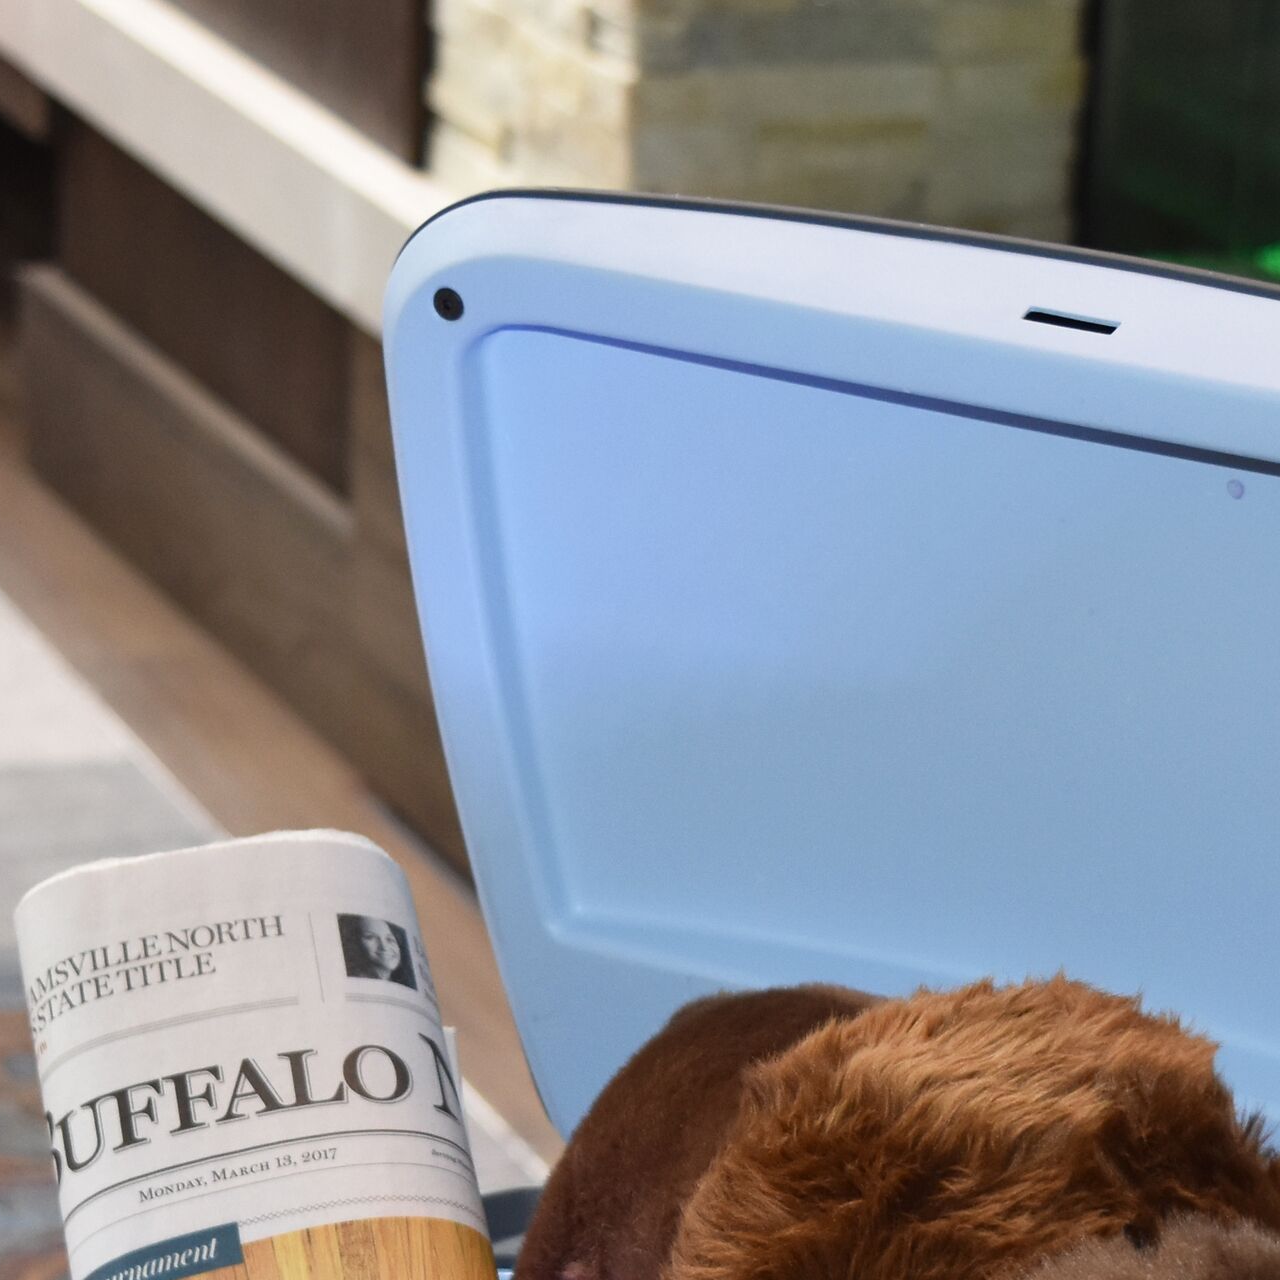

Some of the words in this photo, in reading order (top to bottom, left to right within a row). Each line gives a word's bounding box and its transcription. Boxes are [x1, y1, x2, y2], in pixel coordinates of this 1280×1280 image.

[168, 915, 285, 953] NORTH
[117, 952, 216, 993] TITLE
[275, 1154, 298, 1170] 13,
[301, 1148, 338, 1164] 2017
